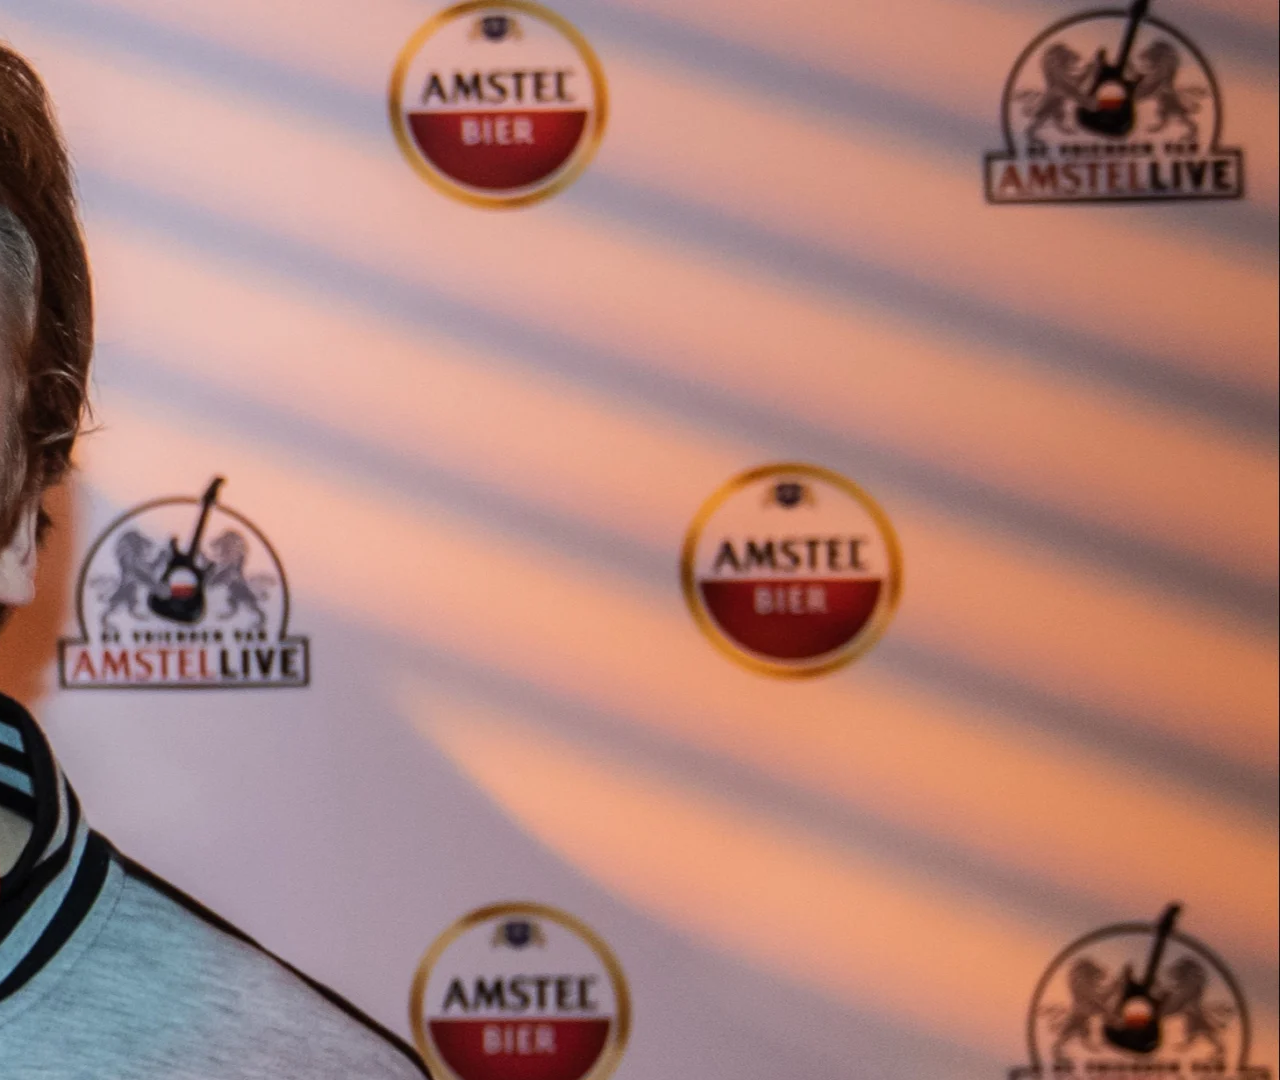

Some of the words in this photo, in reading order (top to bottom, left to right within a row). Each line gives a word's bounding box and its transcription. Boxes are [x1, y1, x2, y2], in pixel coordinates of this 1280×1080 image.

[423, 71, 574, 104] AMSTEL
[461, 117, 534, 145] BIER
[714, 537, 868, 571] AMSTEL
[753, 587, 827, 614] BIER
[442, 976, 598, 1012] AMSTEL
[482, 1026, 556, 1054] BIER
